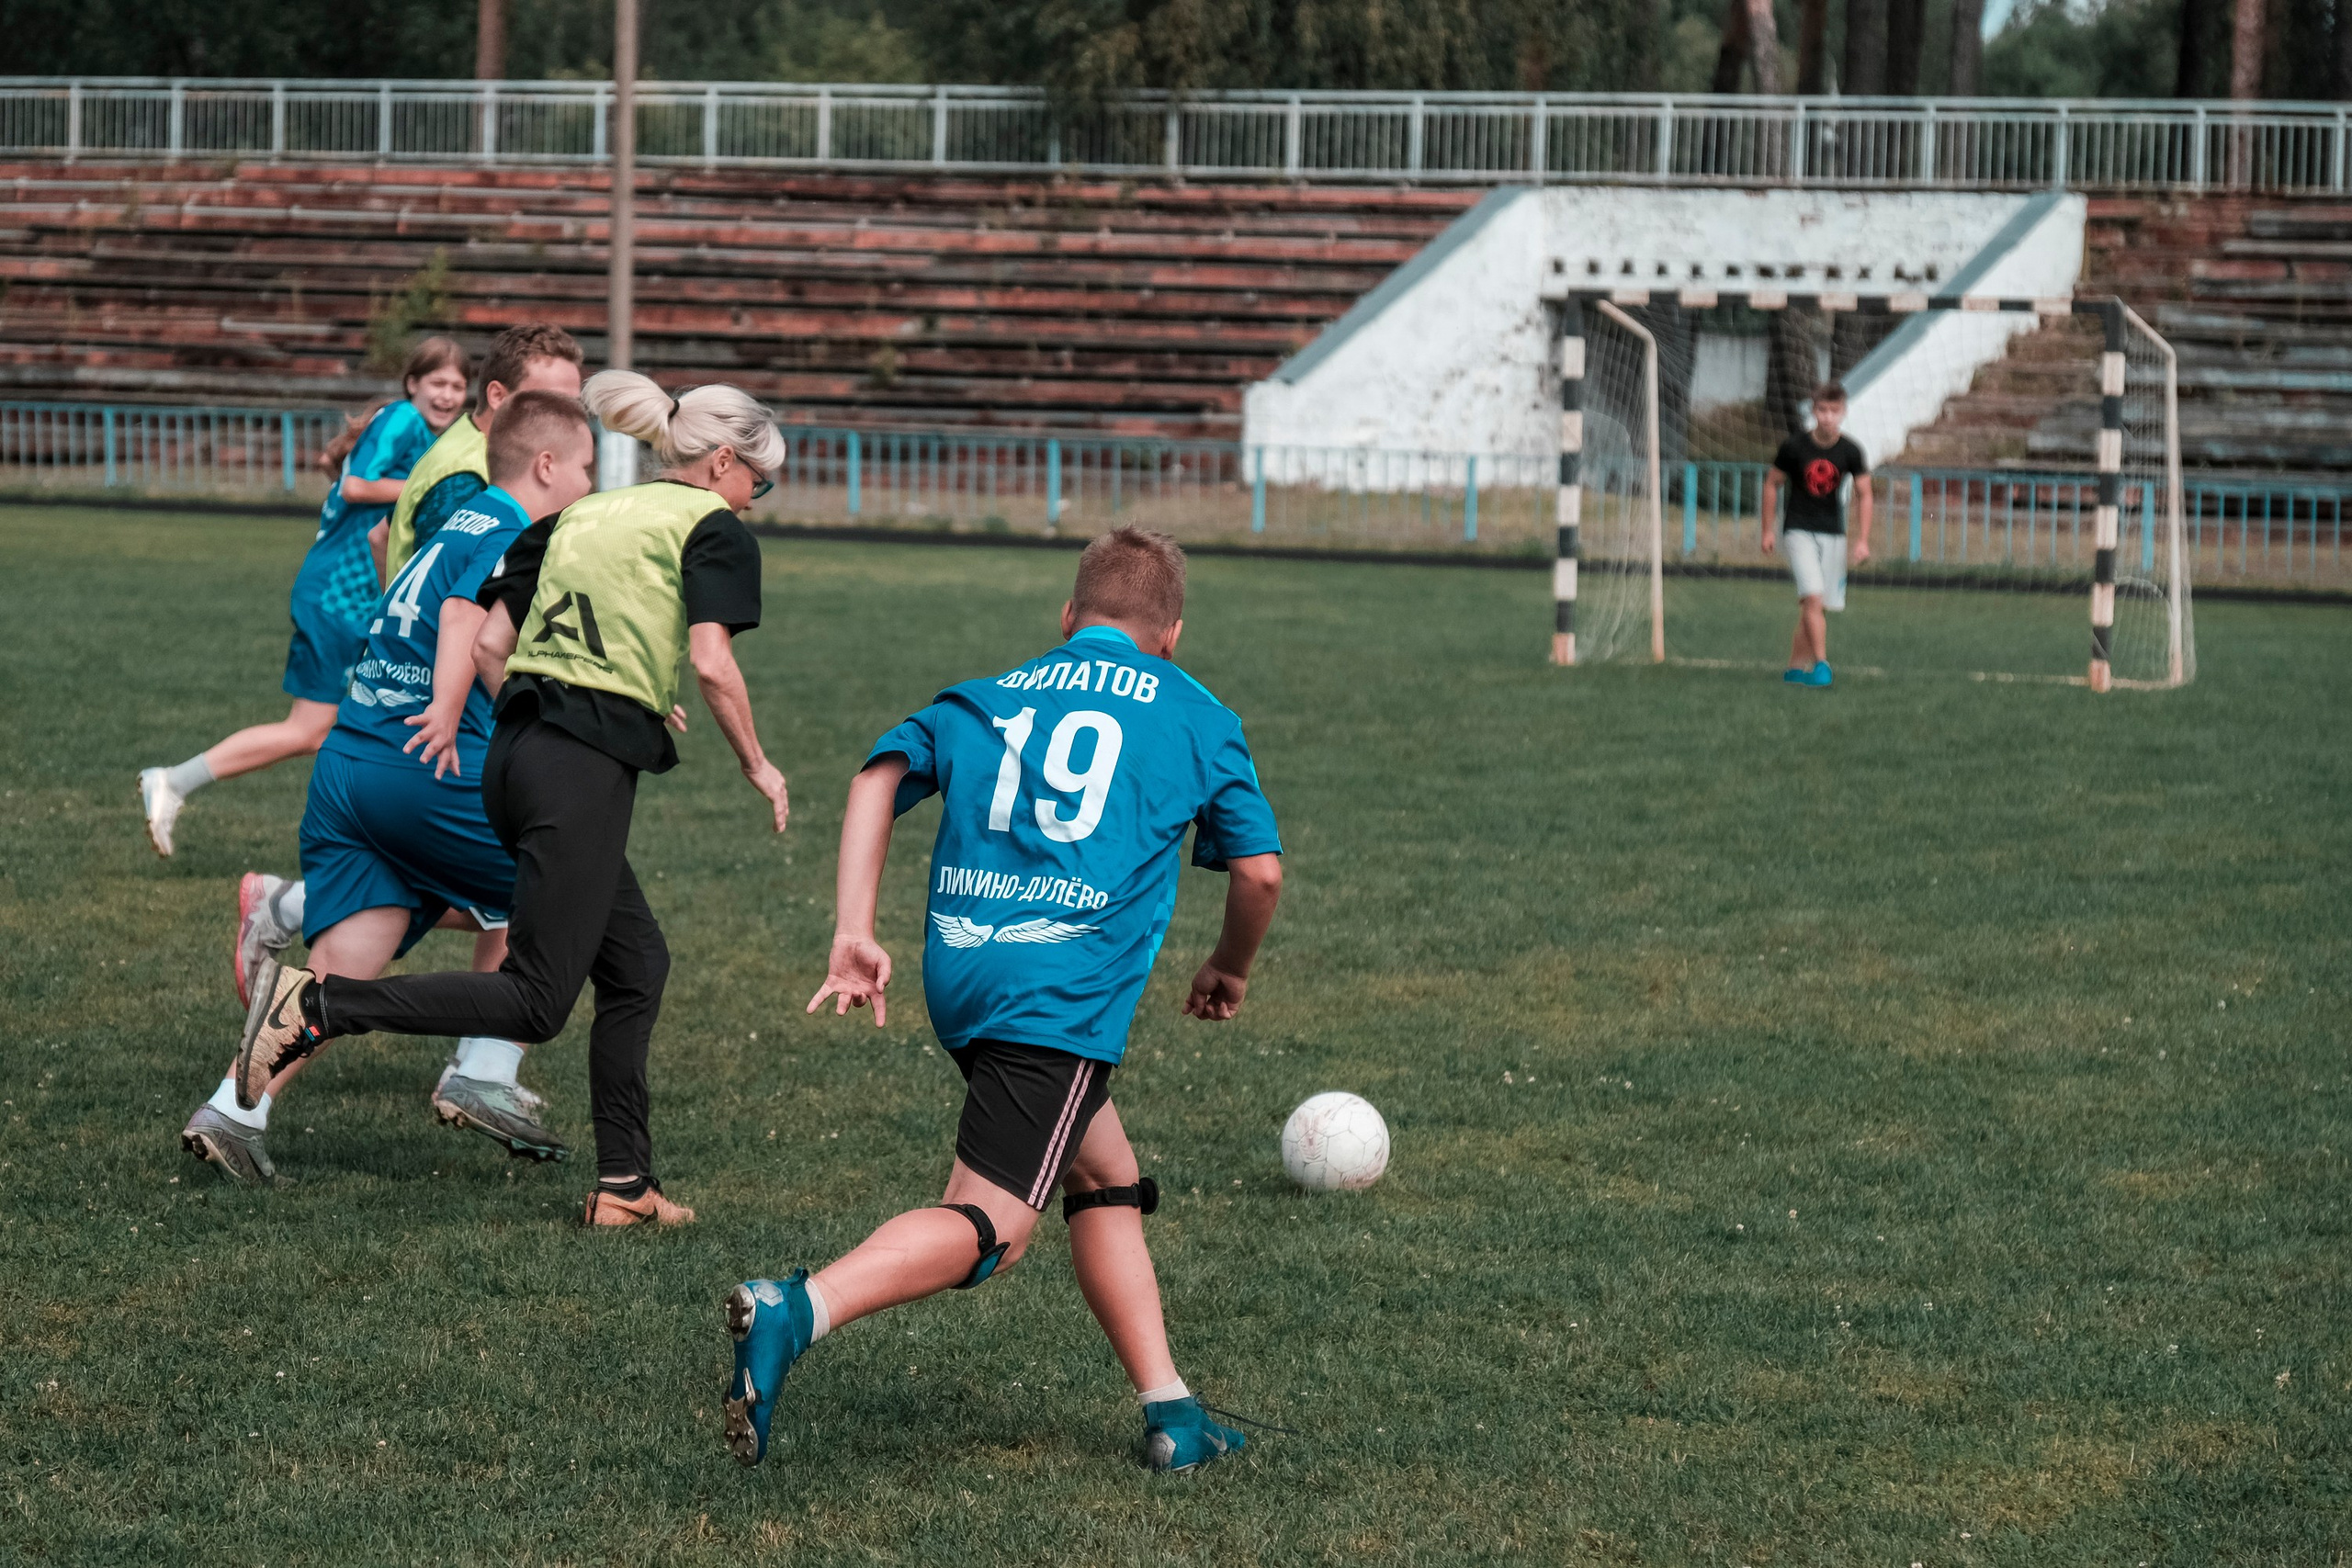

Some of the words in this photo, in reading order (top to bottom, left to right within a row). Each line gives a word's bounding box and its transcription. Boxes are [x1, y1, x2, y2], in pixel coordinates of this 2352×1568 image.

[996, 660, 1159, 704] ФИЛАТОВ
[989, 706, 1124, 842] 19
[936, 865, 1109, 910] ЛИКИНО-ДУЛЁВО
